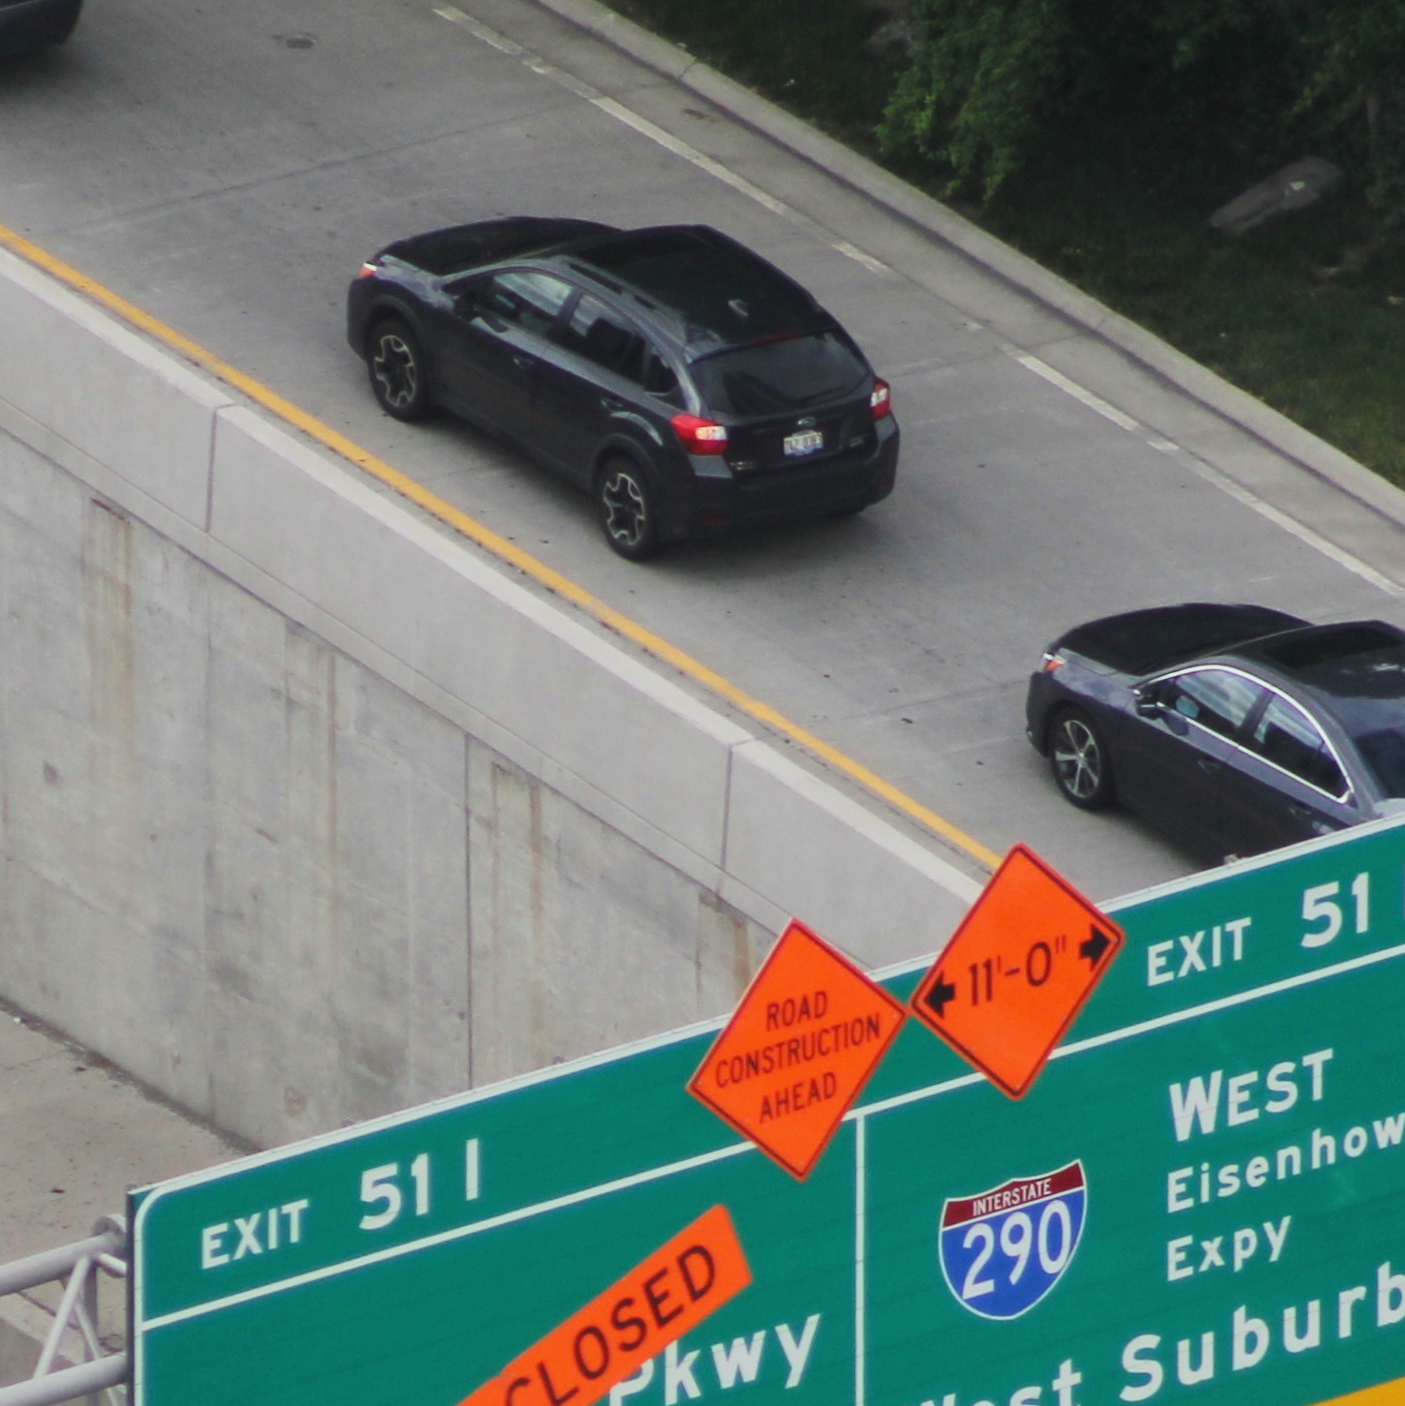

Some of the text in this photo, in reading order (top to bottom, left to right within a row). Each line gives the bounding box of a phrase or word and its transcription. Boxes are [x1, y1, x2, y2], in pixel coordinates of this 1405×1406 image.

[1147, 917, 1252, 986] EXIT
[1301, 872, 1369, 948] 51
[765, 990, 829, 1032] ROAD
[714, 1012, 881, 1089] CONSTRUCTION
[758, 1071, 838, 1125] AHEAD
[1170, 1049, 1334, 1142] WEST
[201, 1199, 309, 1270] EXIT
[358, 1152, 432, 1231] 51
[972, 1177, 1052, 1217] INTERSTATE
[961, 1199, 1072, 1301] 290
[1166, 1216, 1292, 1282] Expy
